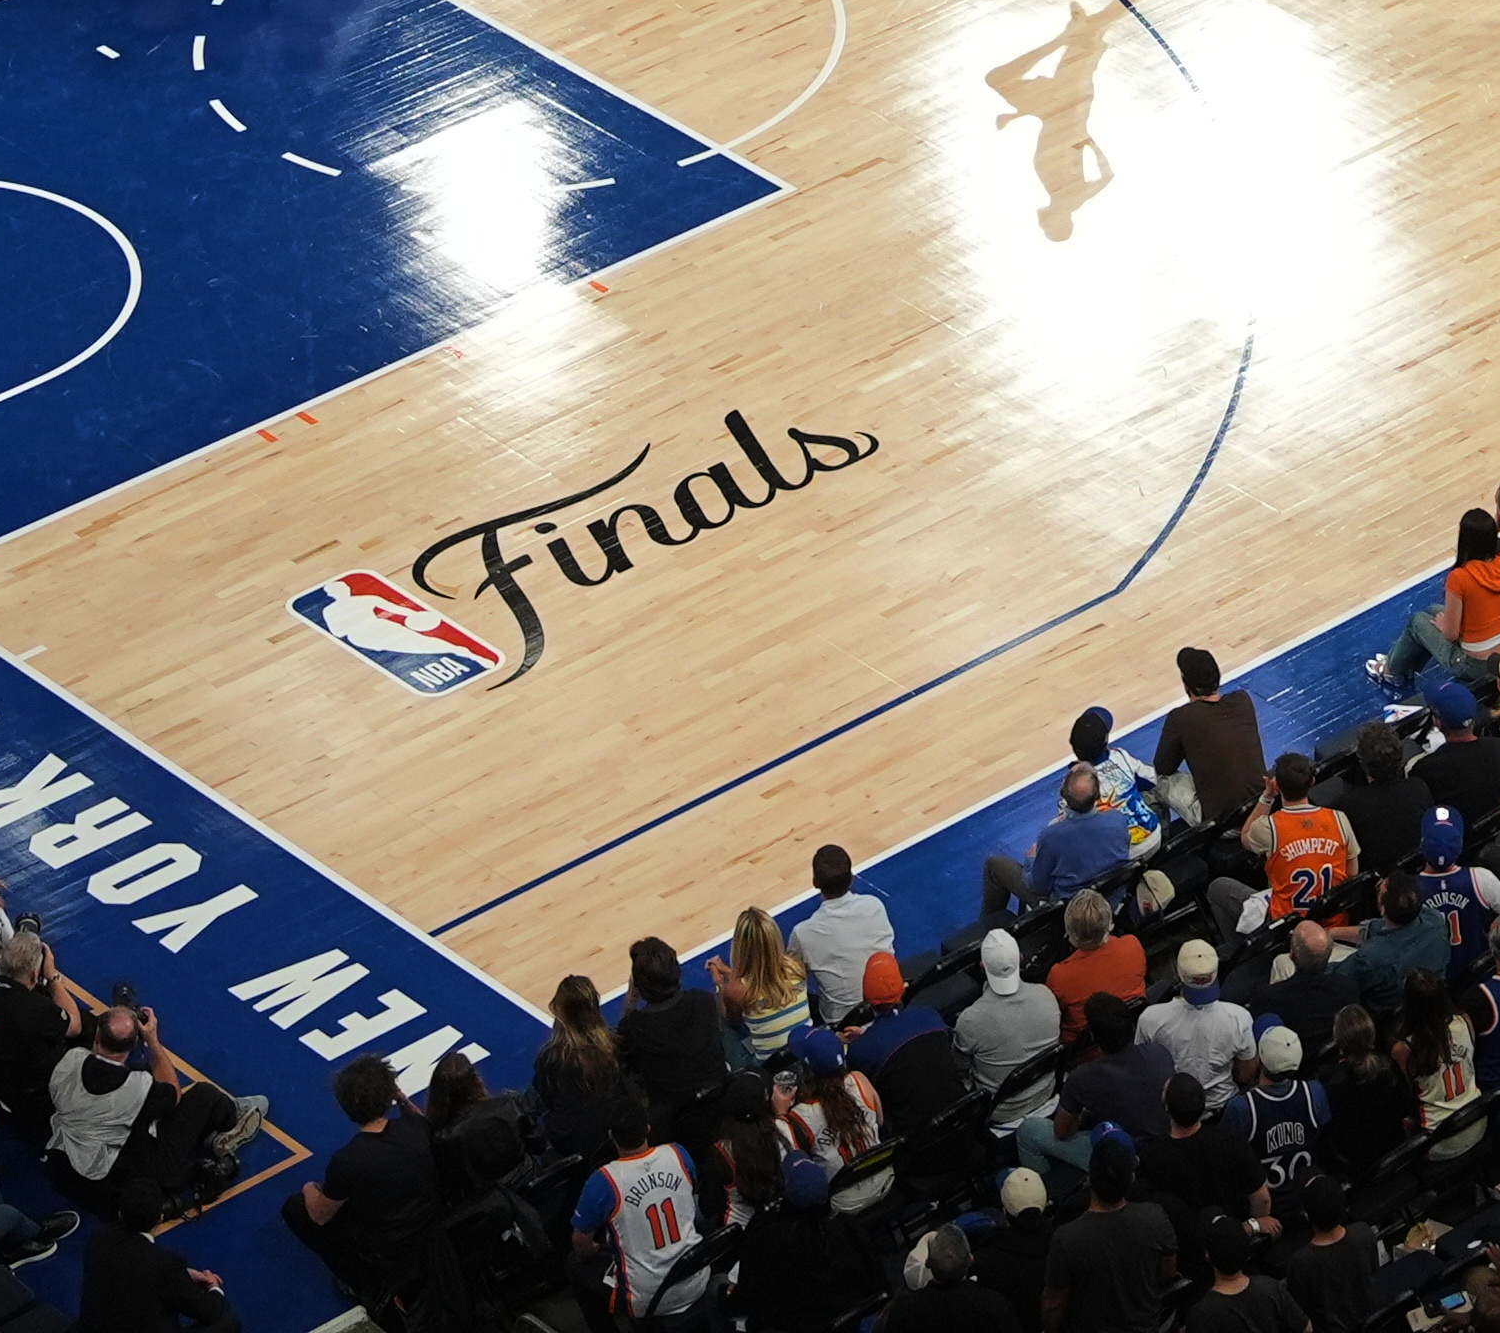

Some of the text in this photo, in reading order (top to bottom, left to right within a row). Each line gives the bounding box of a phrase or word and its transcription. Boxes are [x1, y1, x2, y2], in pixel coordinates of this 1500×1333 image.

[412, 409, 880, 693] Finals
[410, 653, 471, 693] NBA
[1280, 835, 1340, 861] SHUMPERT
[1290, 863, 1335, 912] 21
[228, 948, 490, 1099] NEW
[1265, 1122, 1306, 1150] KING
[623, 1170, 687, 1209] BRUNSON
[644, 1199, 681, 1250] 11
